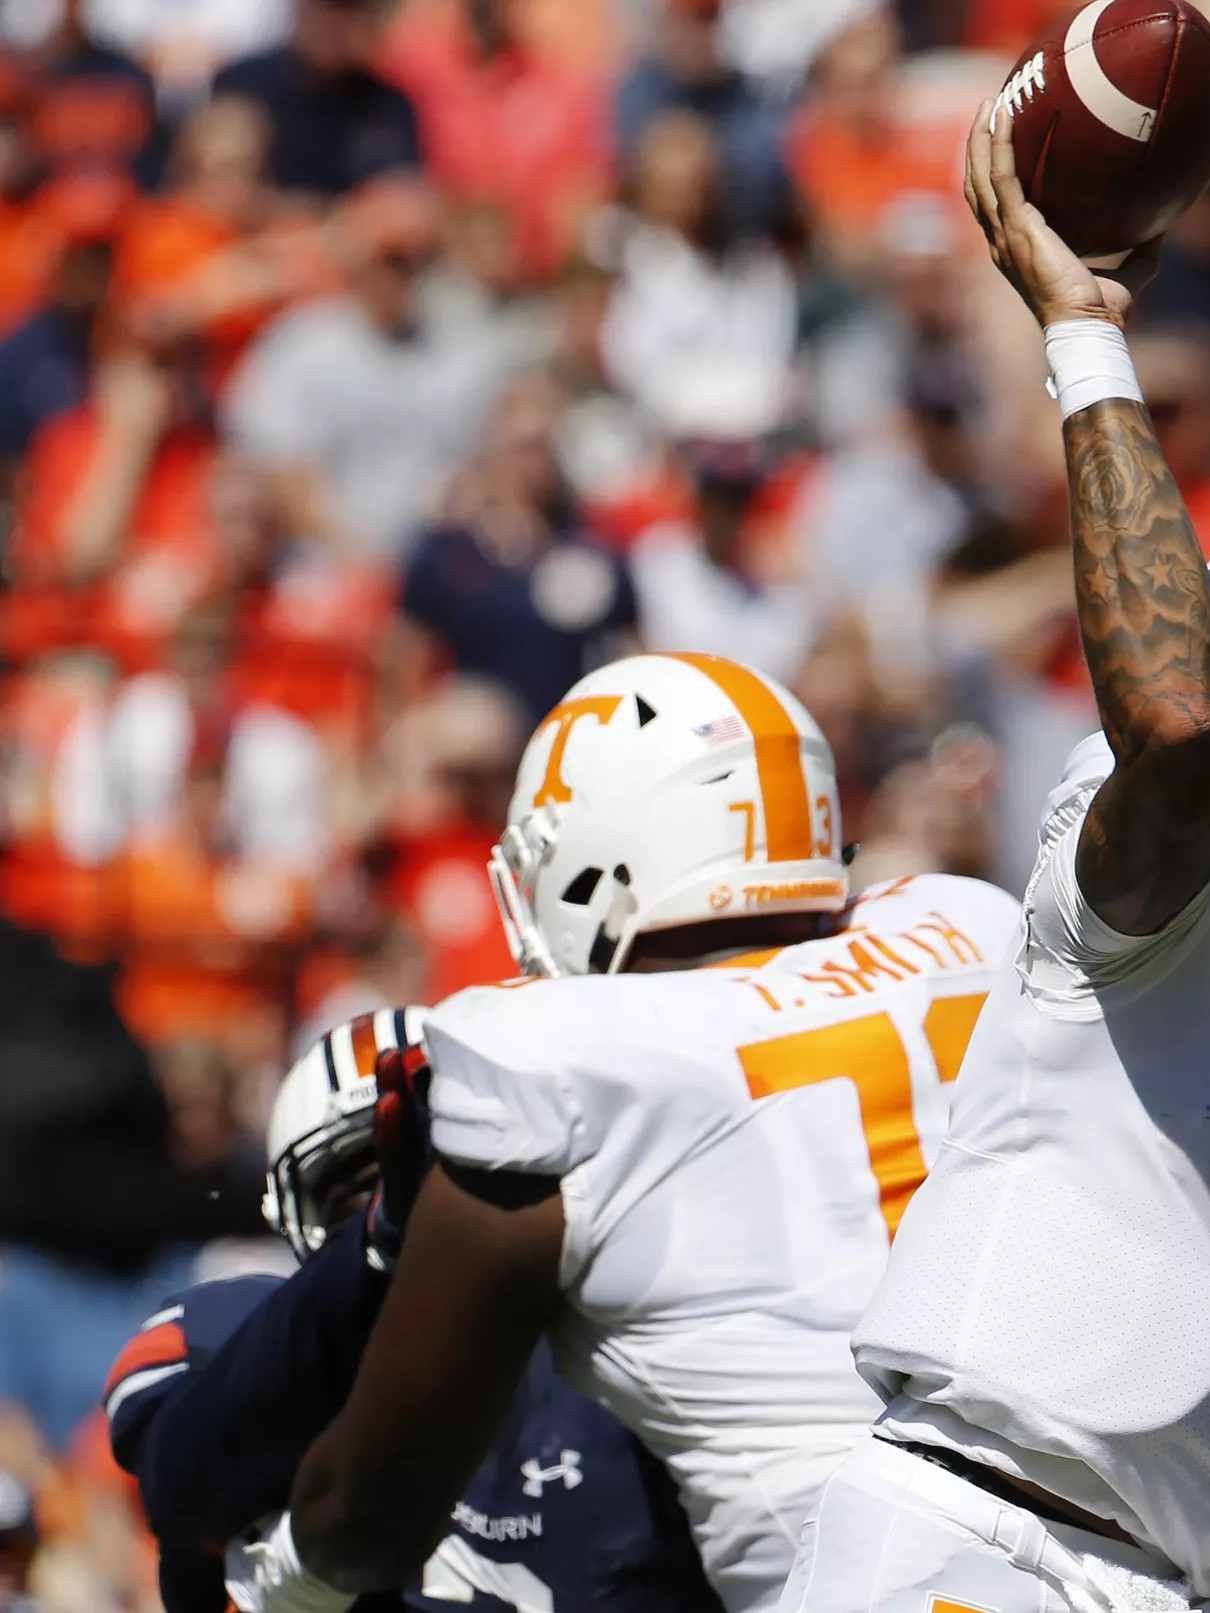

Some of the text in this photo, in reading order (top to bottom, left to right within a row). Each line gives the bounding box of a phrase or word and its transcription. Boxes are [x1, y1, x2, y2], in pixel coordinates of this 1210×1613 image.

[533, 695, 624, 808] T
[728, 911, 985, 1012] T. SMITH
[735, 991, 991, 1250] 7
